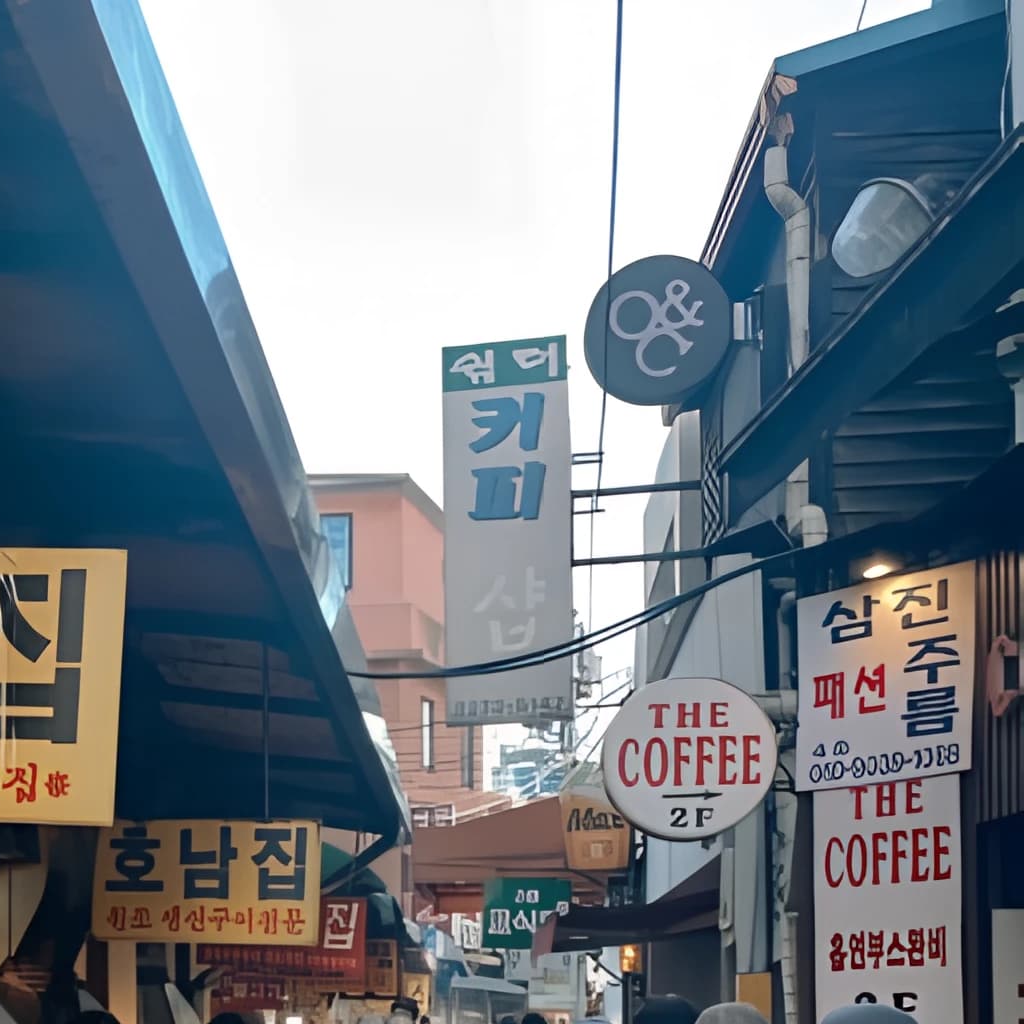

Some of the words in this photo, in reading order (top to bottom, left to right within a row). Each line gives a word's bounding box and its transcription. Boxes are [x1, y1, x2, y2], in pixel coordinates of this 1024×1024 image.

[648, 702, 730, 729] THE
[812, 663, 887, 720] 패션
[617, 734, 762, 788] COFFEE
[669, 807, 715, 828] 2F
[848, 777, 924, 820] THE
[105, 826, 308, 901] 호남집
[824, 825, 952, 888] COFFEE
[323, 902, 359, 950] 집
